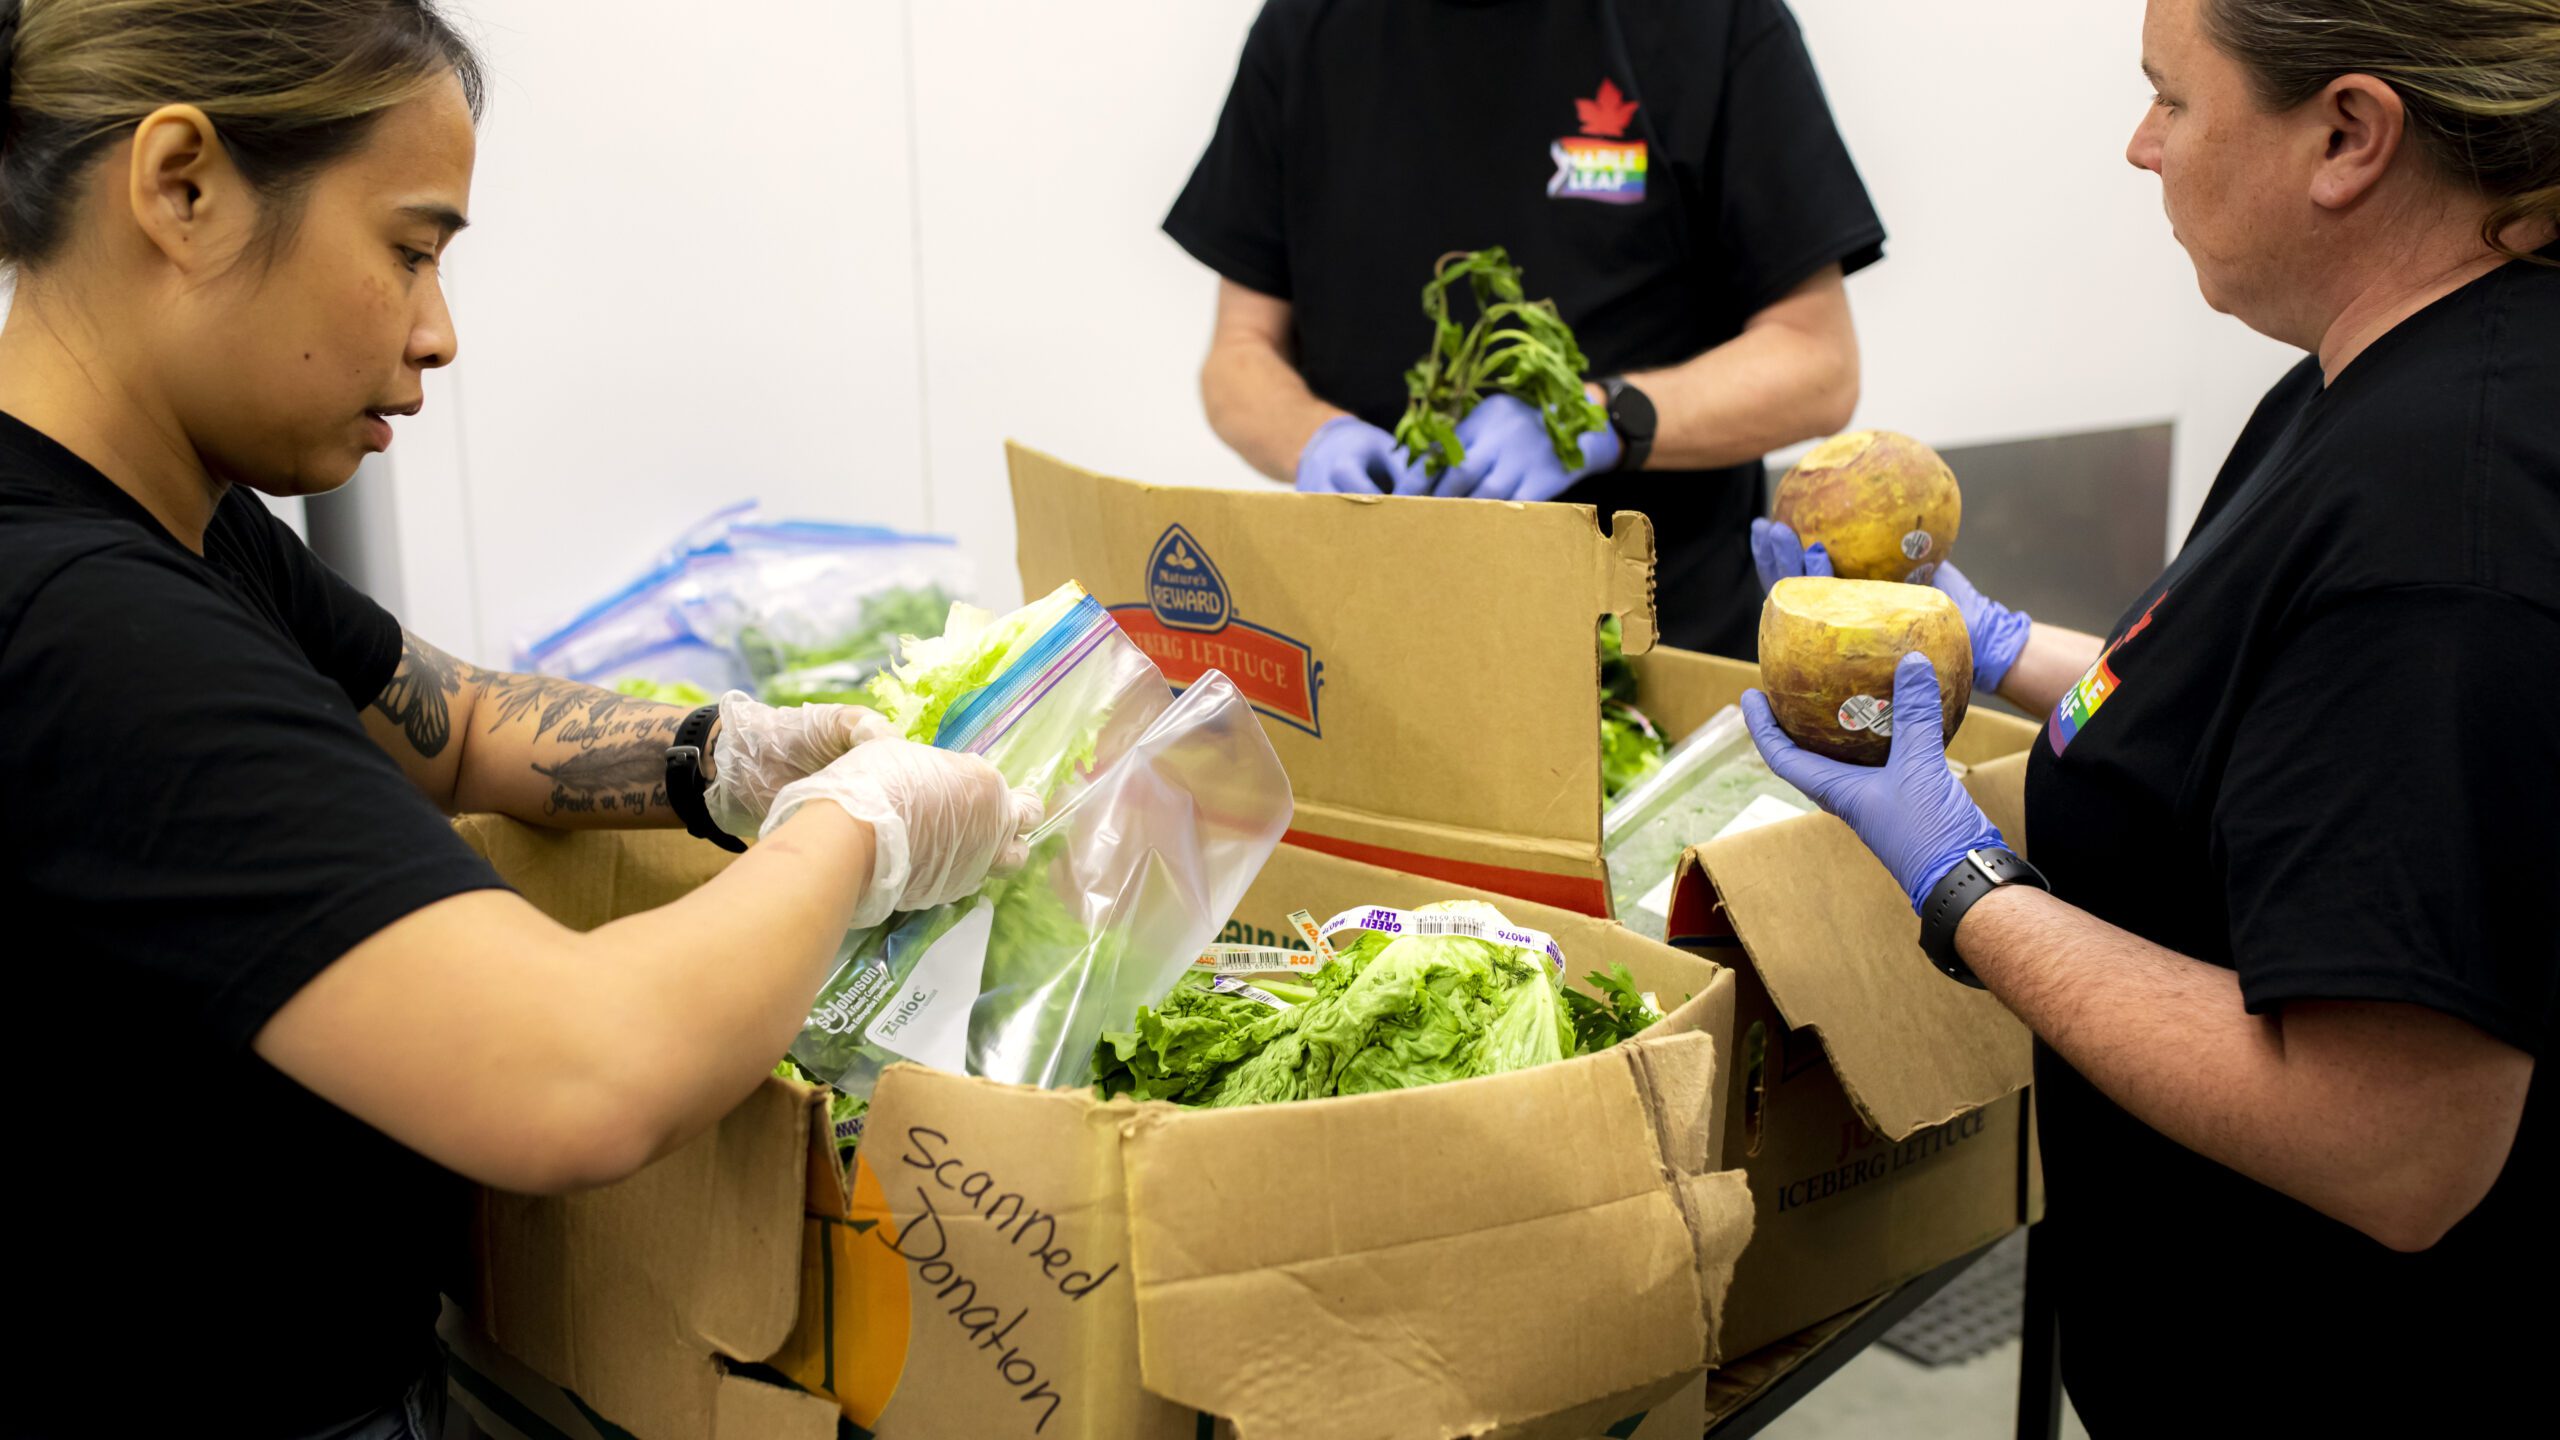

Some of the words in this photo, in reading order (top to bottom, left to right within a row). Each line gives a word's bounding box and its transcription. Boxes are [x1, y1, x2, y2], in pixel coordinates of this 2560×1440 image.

[1568, 169, 1626, 191] LEAF
[1159, 569, 1208, 587] Nature's
[1153, 585, 1221, 615] REWARD
[1191, 636, 1288, 689] LETTUCE
[622, 791, 646, 816] my
[1360, 917, 1402, 933] GREEN
[1368, 909, 1397, 923] LEAF
[1498, 930, 1531, 944] #4076
[880, 991, 926, 1036] Ziploc
[1778, 1153, 1886, 1214] ICEBERG
[1892, 1107, 1985, 1173] LETTUCE
[902, 1126, 1120, 1302] Scanned
[876, 1185, 1062, 1435] Donation
